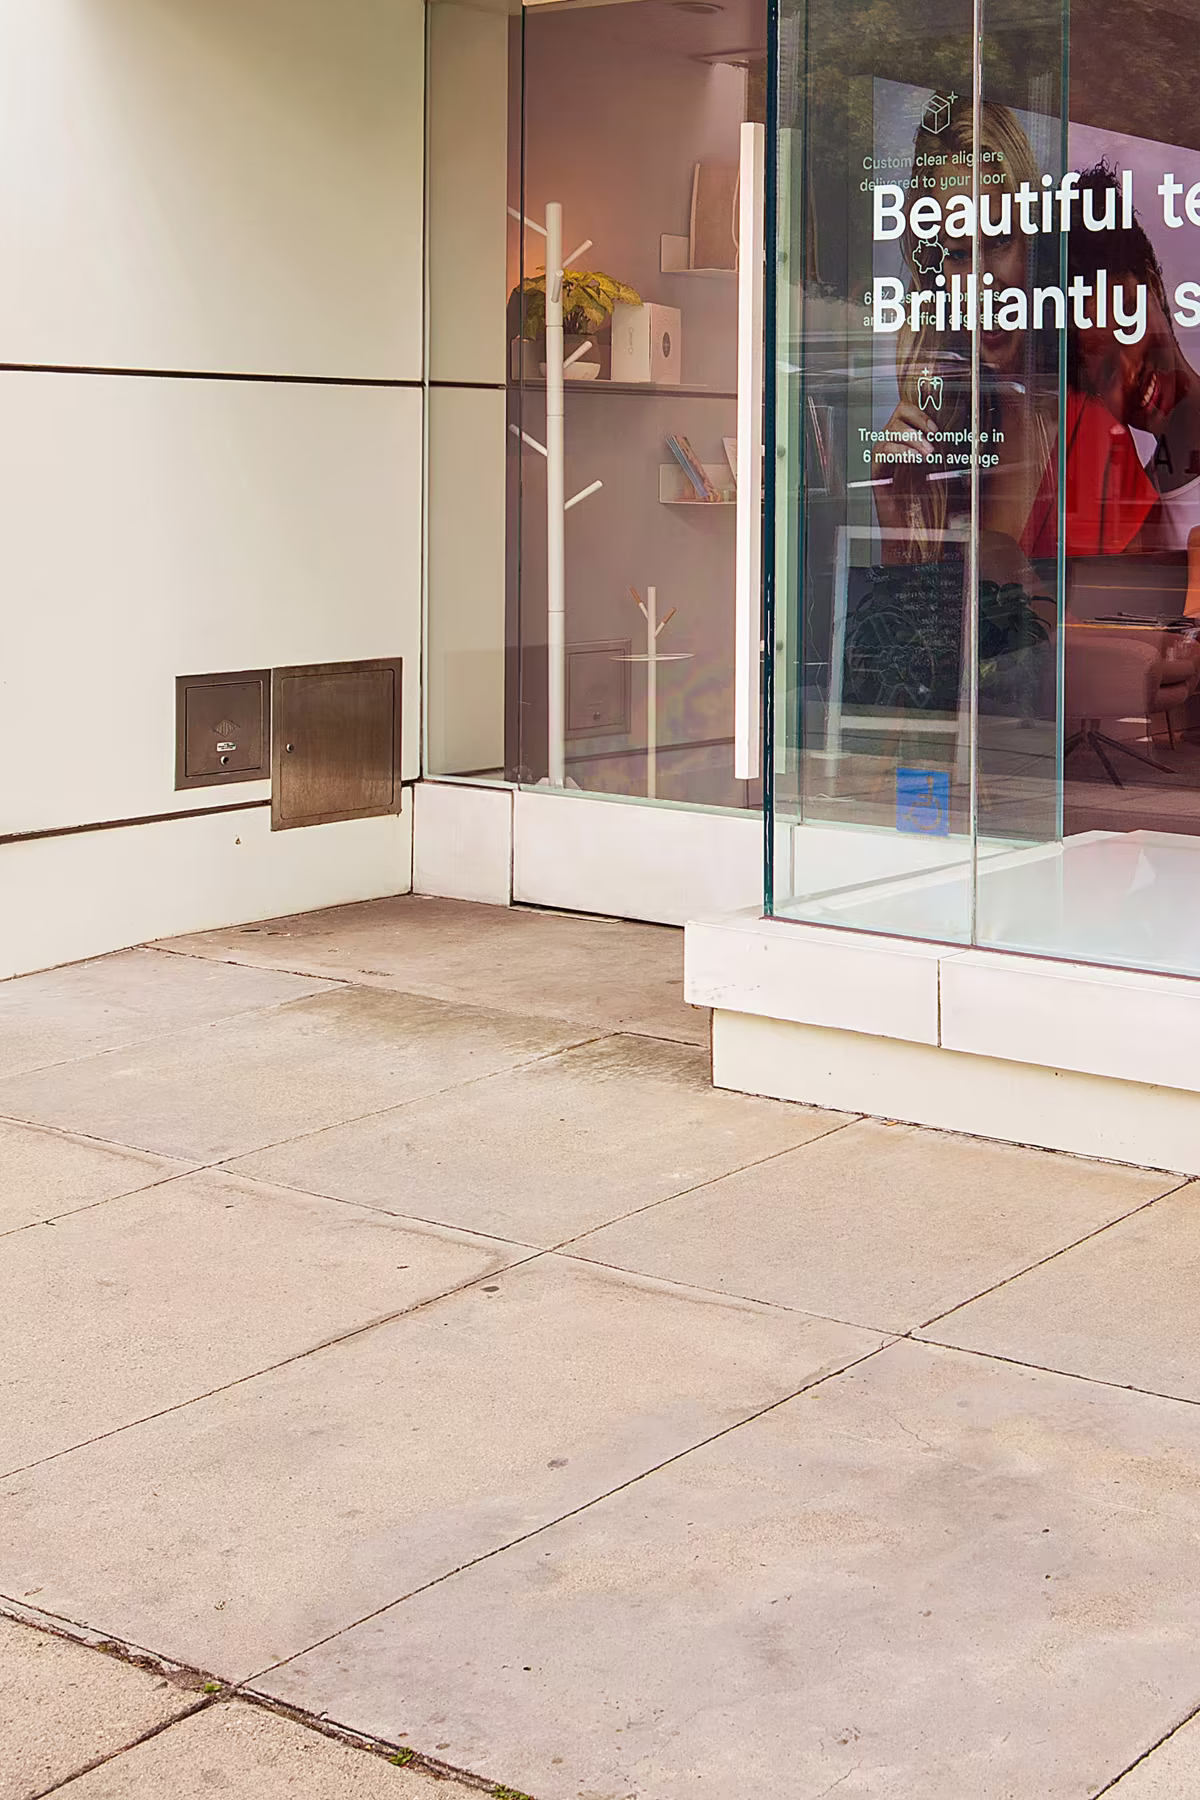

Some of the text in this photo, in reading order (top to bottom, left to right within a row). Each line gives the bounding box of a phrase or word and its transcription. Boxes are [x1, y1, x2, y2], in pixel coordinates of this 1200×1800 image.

[862, 156, 912, 170] Custom
[915, 152, 948, 167] clear
[922, 175, 936, 189] to
[940, 175, 971, 191] your
[872, 169, 1134, 241] Beautiful
[872, 268, 1148, 346] Brilliantly
[857, 428, 1005, 446] Treatment complee in
[862, 449, 871, 464] 6
[874, 450, 923, 464] months
[926, 453, 943, 464] on
